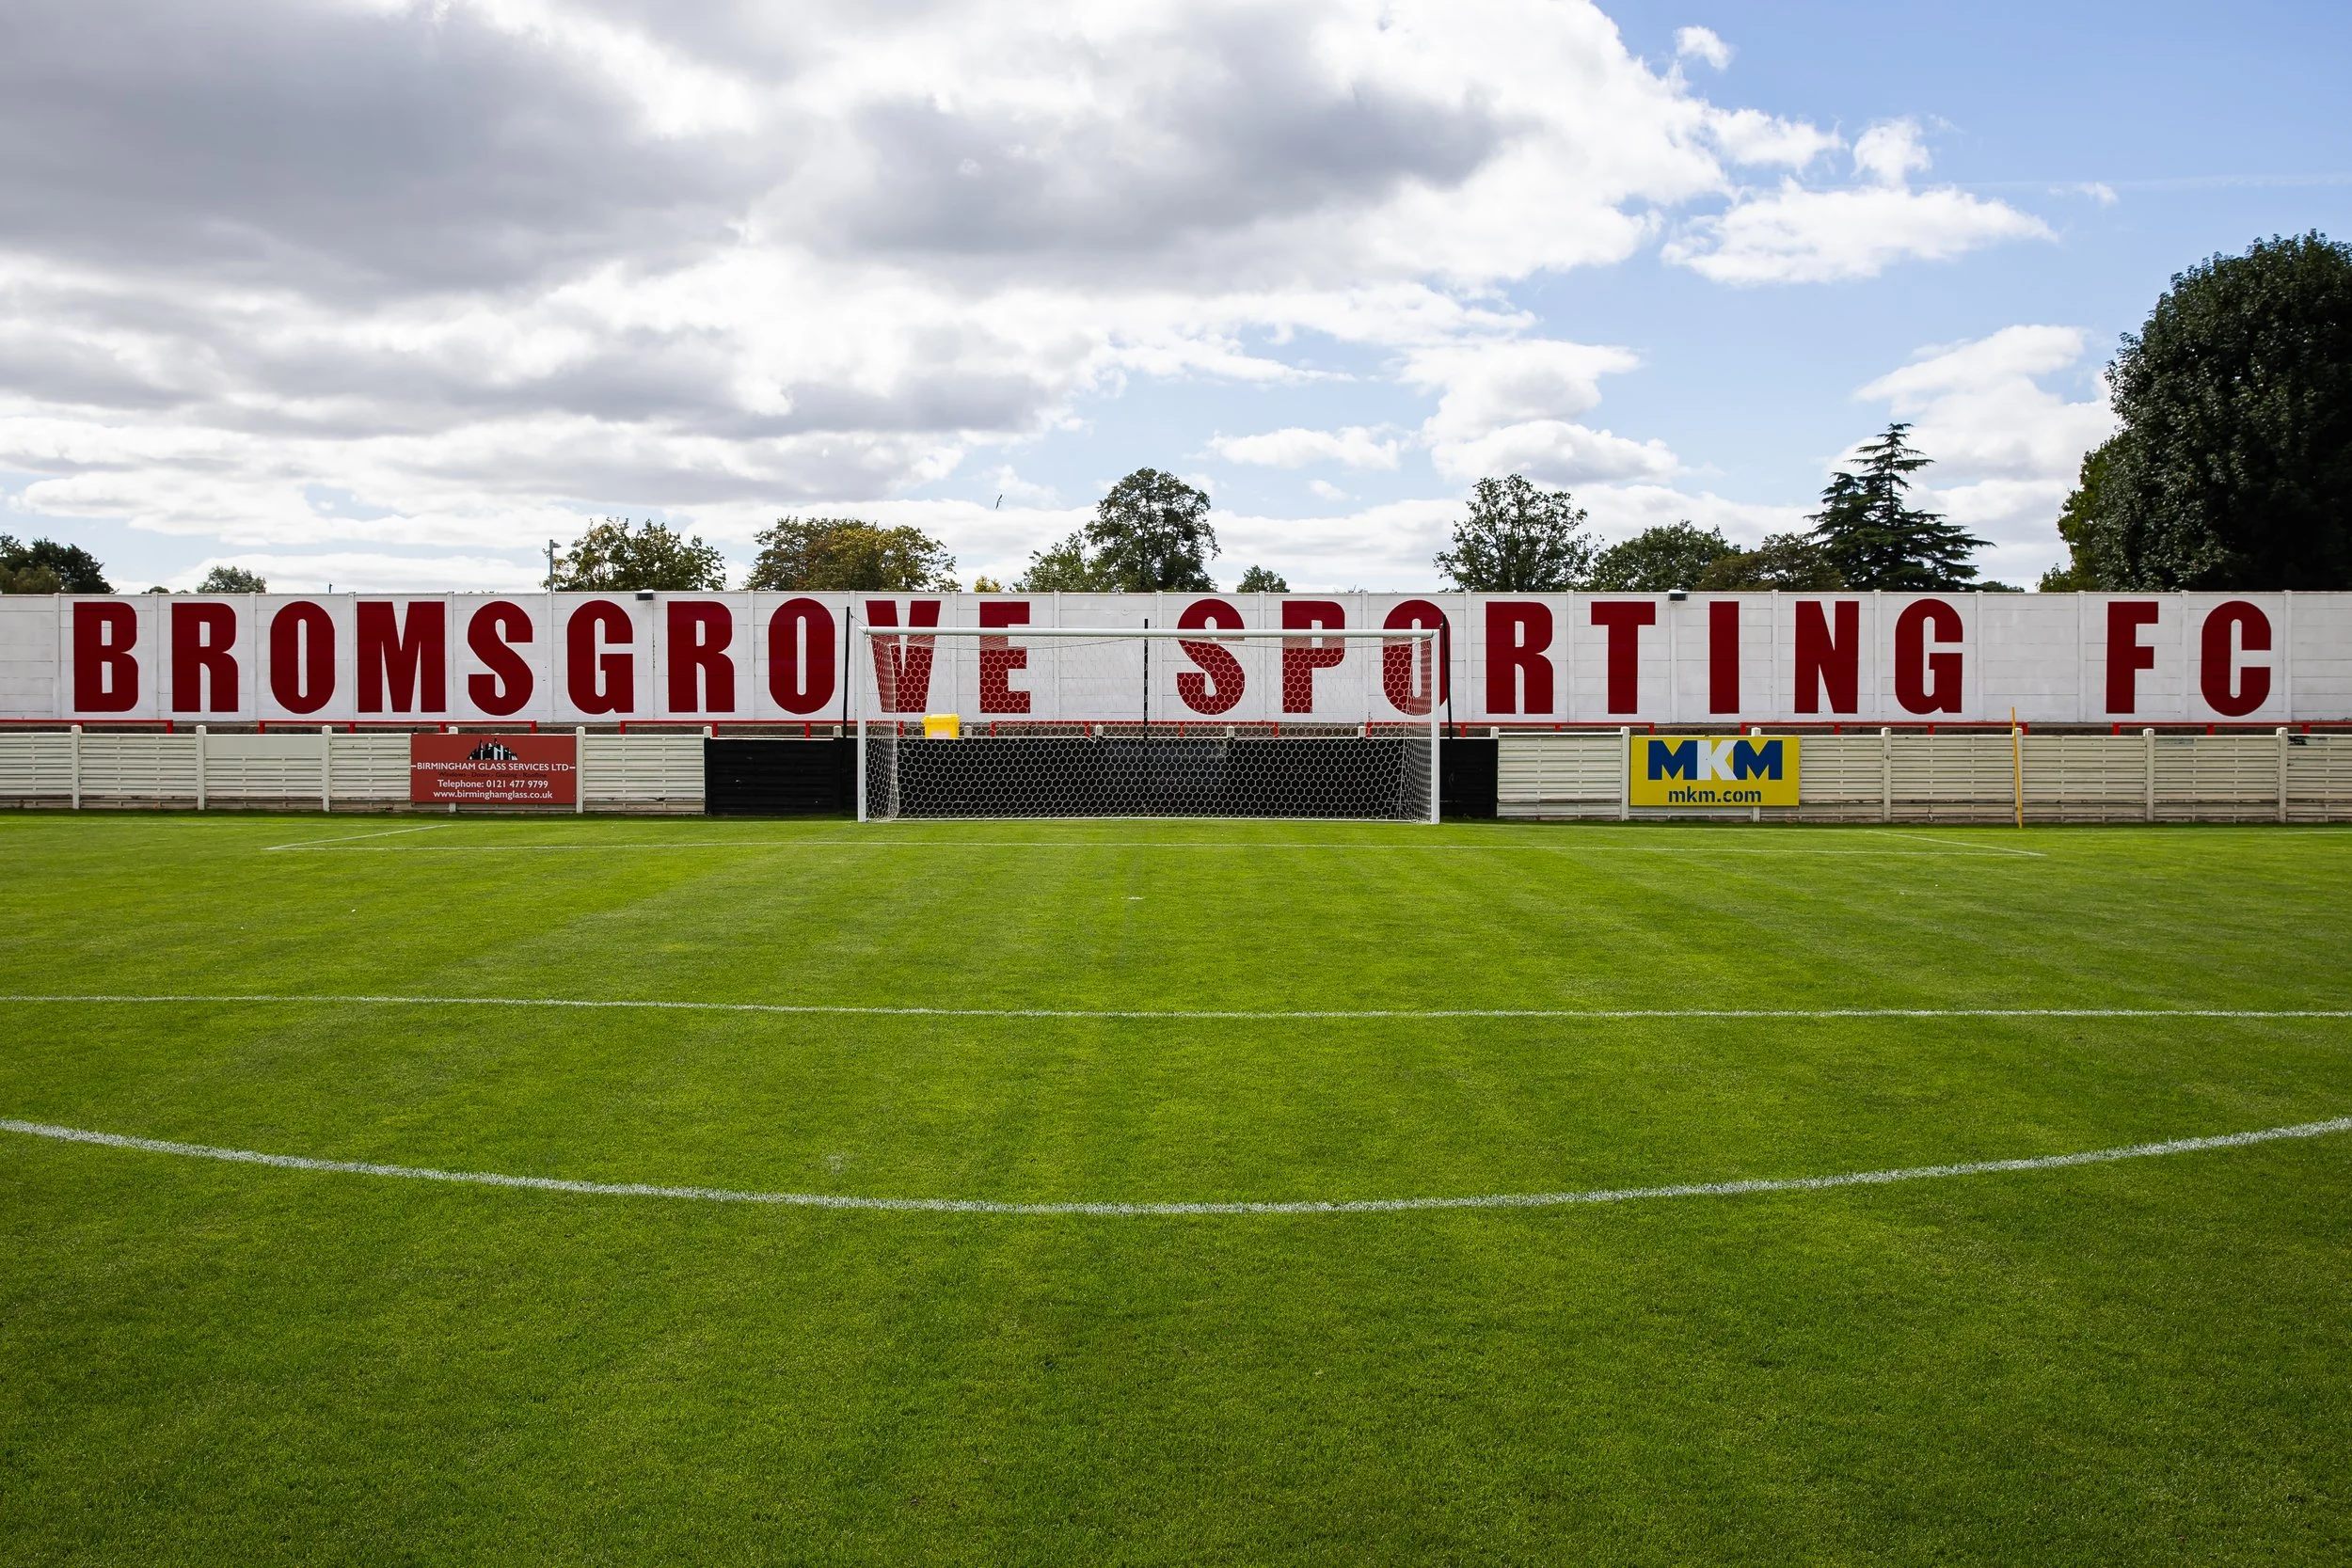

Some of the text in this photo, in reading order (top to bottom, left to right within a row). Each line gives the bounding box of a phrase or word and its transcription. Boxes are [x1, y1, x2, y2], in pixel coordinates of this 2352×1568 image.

[73, 597, 2272, 717] BROMSGROVE SPORTING FC
[417, 762, 569, 771] BIRMINGHAM GLASS SERVICES LTD
[1647, 739, 1783, 781] MKM
[437, 779, 548, 789] Telephone: 0121 477 9799
[433, 790, 553, 800] www.birminghamglass.co.uk
[1668, 785, 1762, 803] mkm.com
